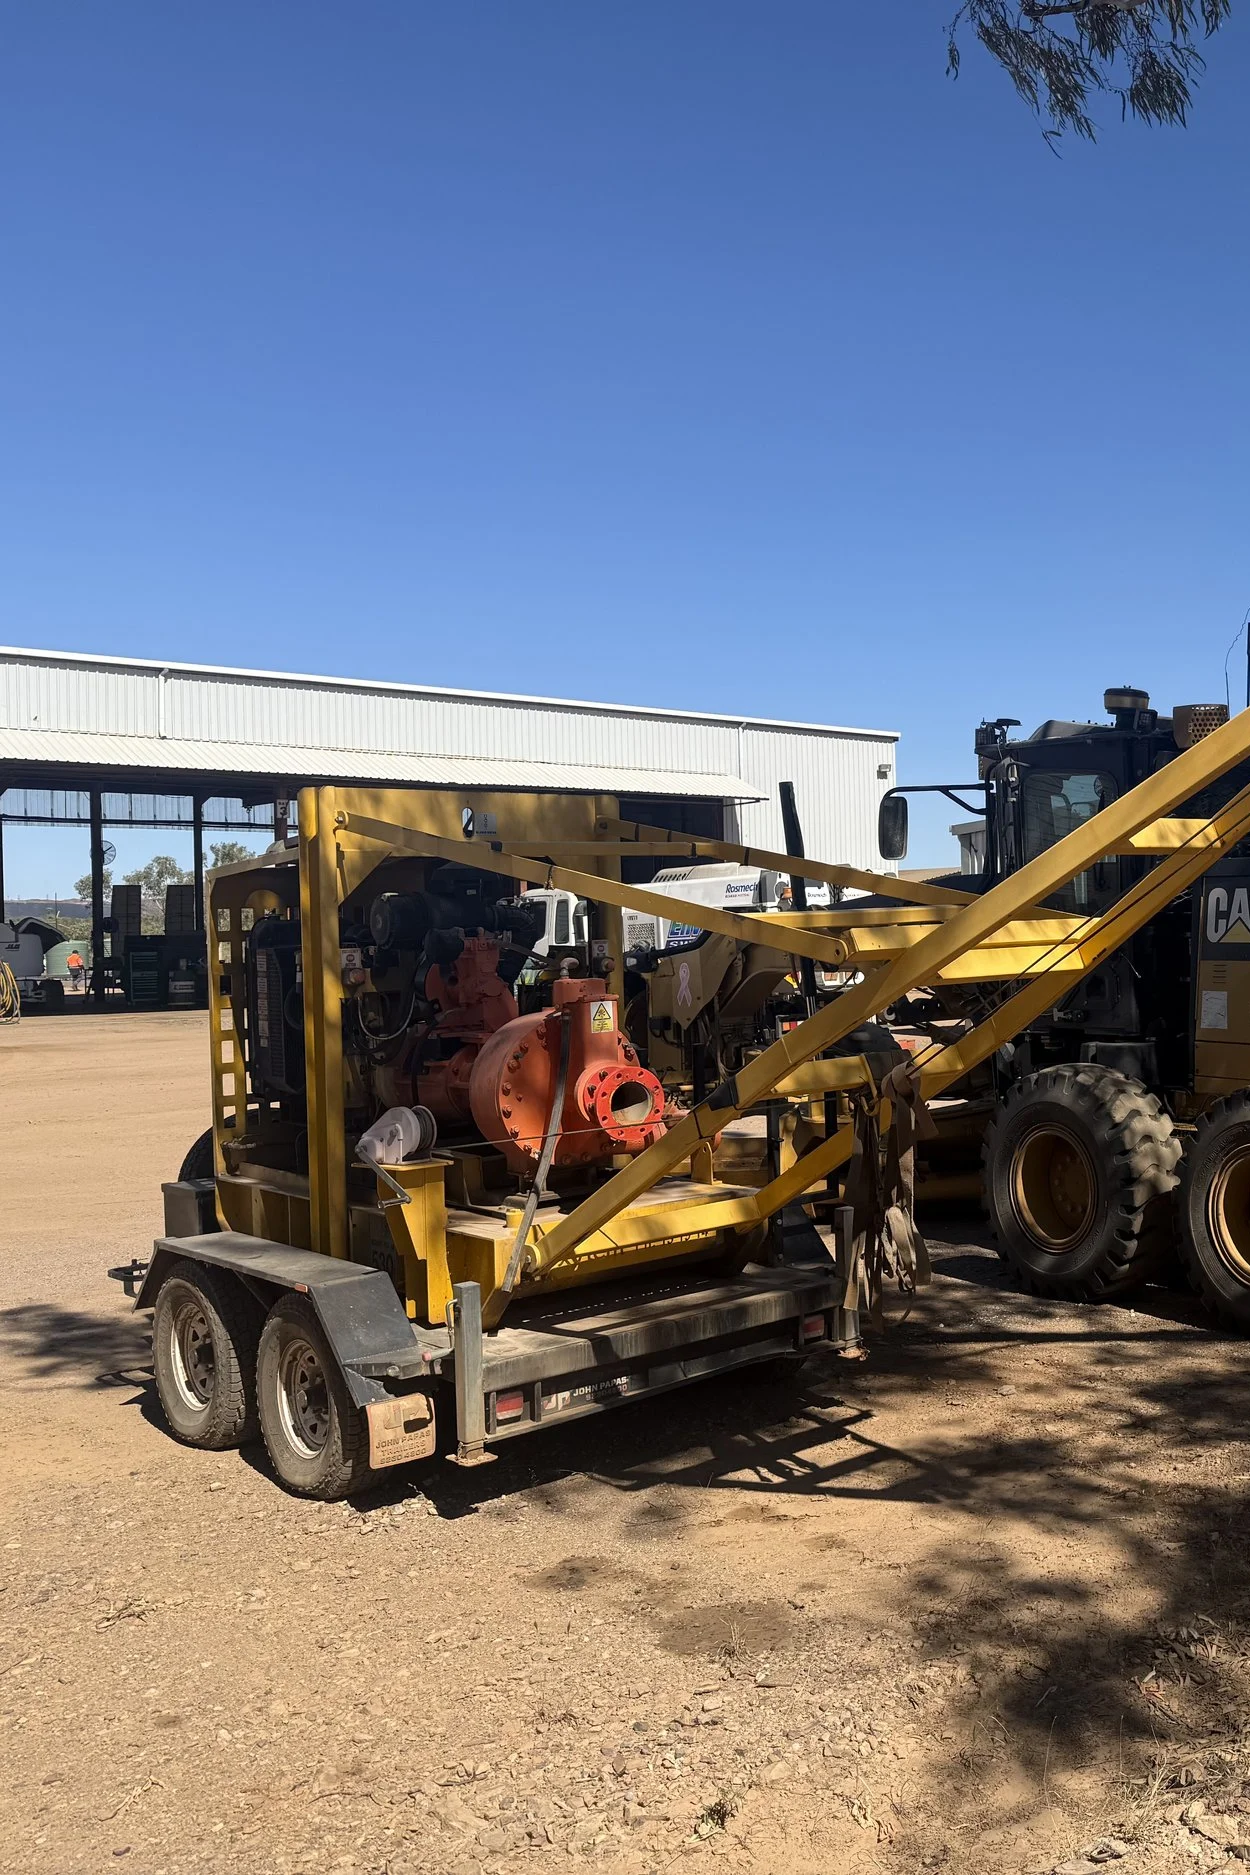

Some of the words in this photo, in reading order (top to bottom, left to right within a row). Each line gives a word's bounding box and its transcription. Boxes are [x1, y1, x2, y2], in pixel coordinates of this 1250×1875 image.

[573, 1383, 598, 1397] JOHN
[375, 1438, 400, 1449] JOHN
[401, 1430, 431, 1443] PAPAS
[381, 1440, 426, 1457] TRAILERS
